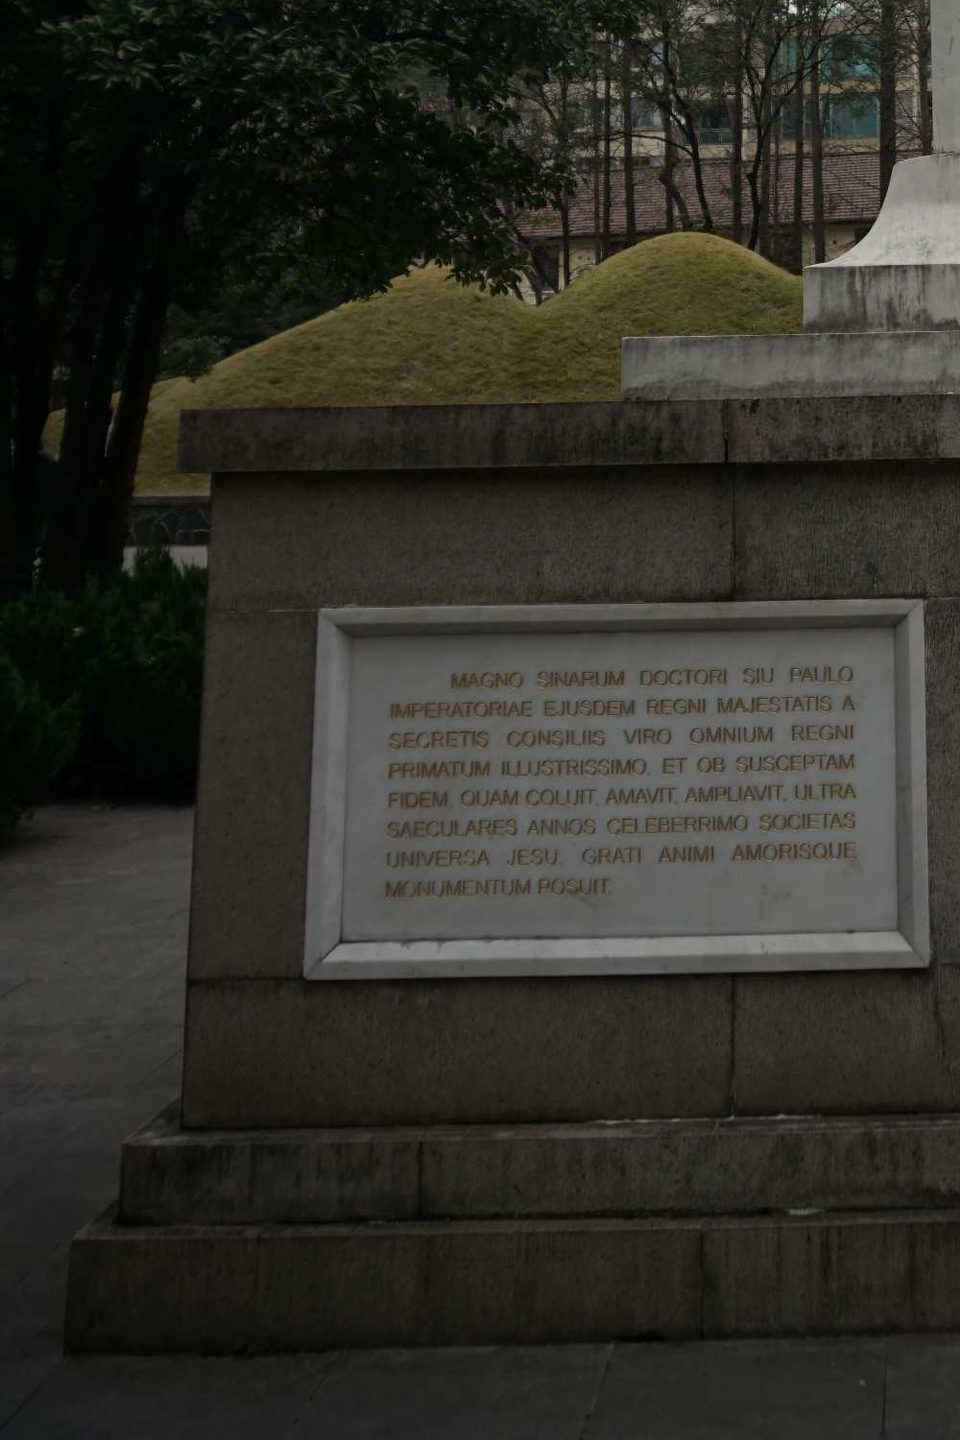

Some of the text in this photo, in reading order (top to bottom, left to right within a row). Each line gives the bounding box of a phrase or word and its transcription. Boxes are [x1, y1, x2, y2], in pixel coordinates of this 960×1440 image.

[450, 666, 854, 689] MAGNO SINARUM DOCTORI SIU PAULO
[390, 696, 856, 718] IMPERATORIAE EJUSDEM REGNI MAJESTATIS A
[389, 725, 854, 749] SECRETIS CONSILIIS VIRO OMNIUM REGNI
[389, 761, 490, 779] PRIMATUM
[663, 757, 687, 774] ET
[697, 757, 726, 773] OB
[735, 754, 855, 773] SUSCEPTAM
[460, 790, 518, 807] QUAM
[795, 783, 856, 801] ULTRA
[386, 813, 856, 838] SAECULARES ANNOS CELEBERRIMO SOCIETAS
[386, 850, 489, 868] UNIVERSA
[582, 847, 642, 865] GRATI
[659, 845, 715, 863] ANIMI
[732, 842, 857, 862] AMORISQUE
[384, 879, 531, 898] MONUMENTUM
